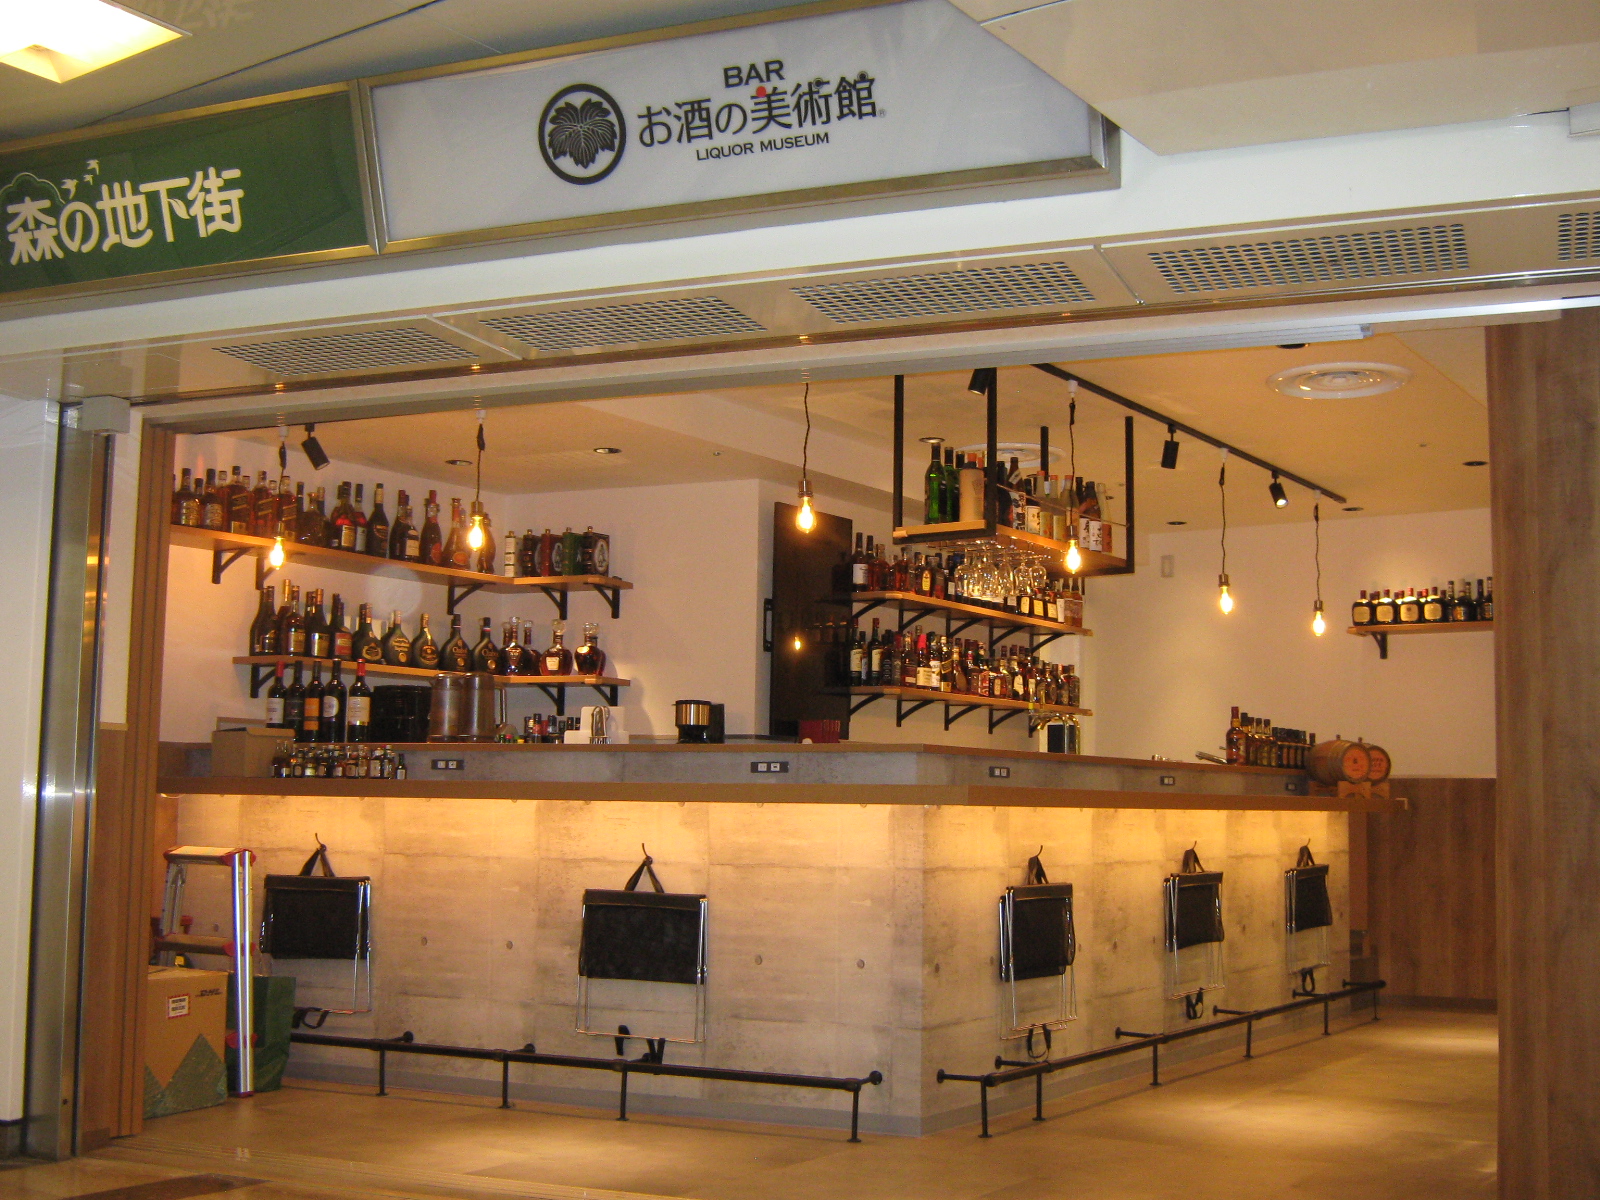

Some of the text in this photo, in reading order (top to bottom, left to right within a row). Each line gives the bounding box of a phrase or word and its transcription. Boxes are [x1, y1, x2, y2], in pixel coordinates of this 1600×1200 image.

[723, 59, 785, 89] BAR
[637, 75, 878, 148] お酒の美術館
[696, 131, 830, 161] LIQUOR MUSEUM
[6, 166, 245, 266] 森の地下街
